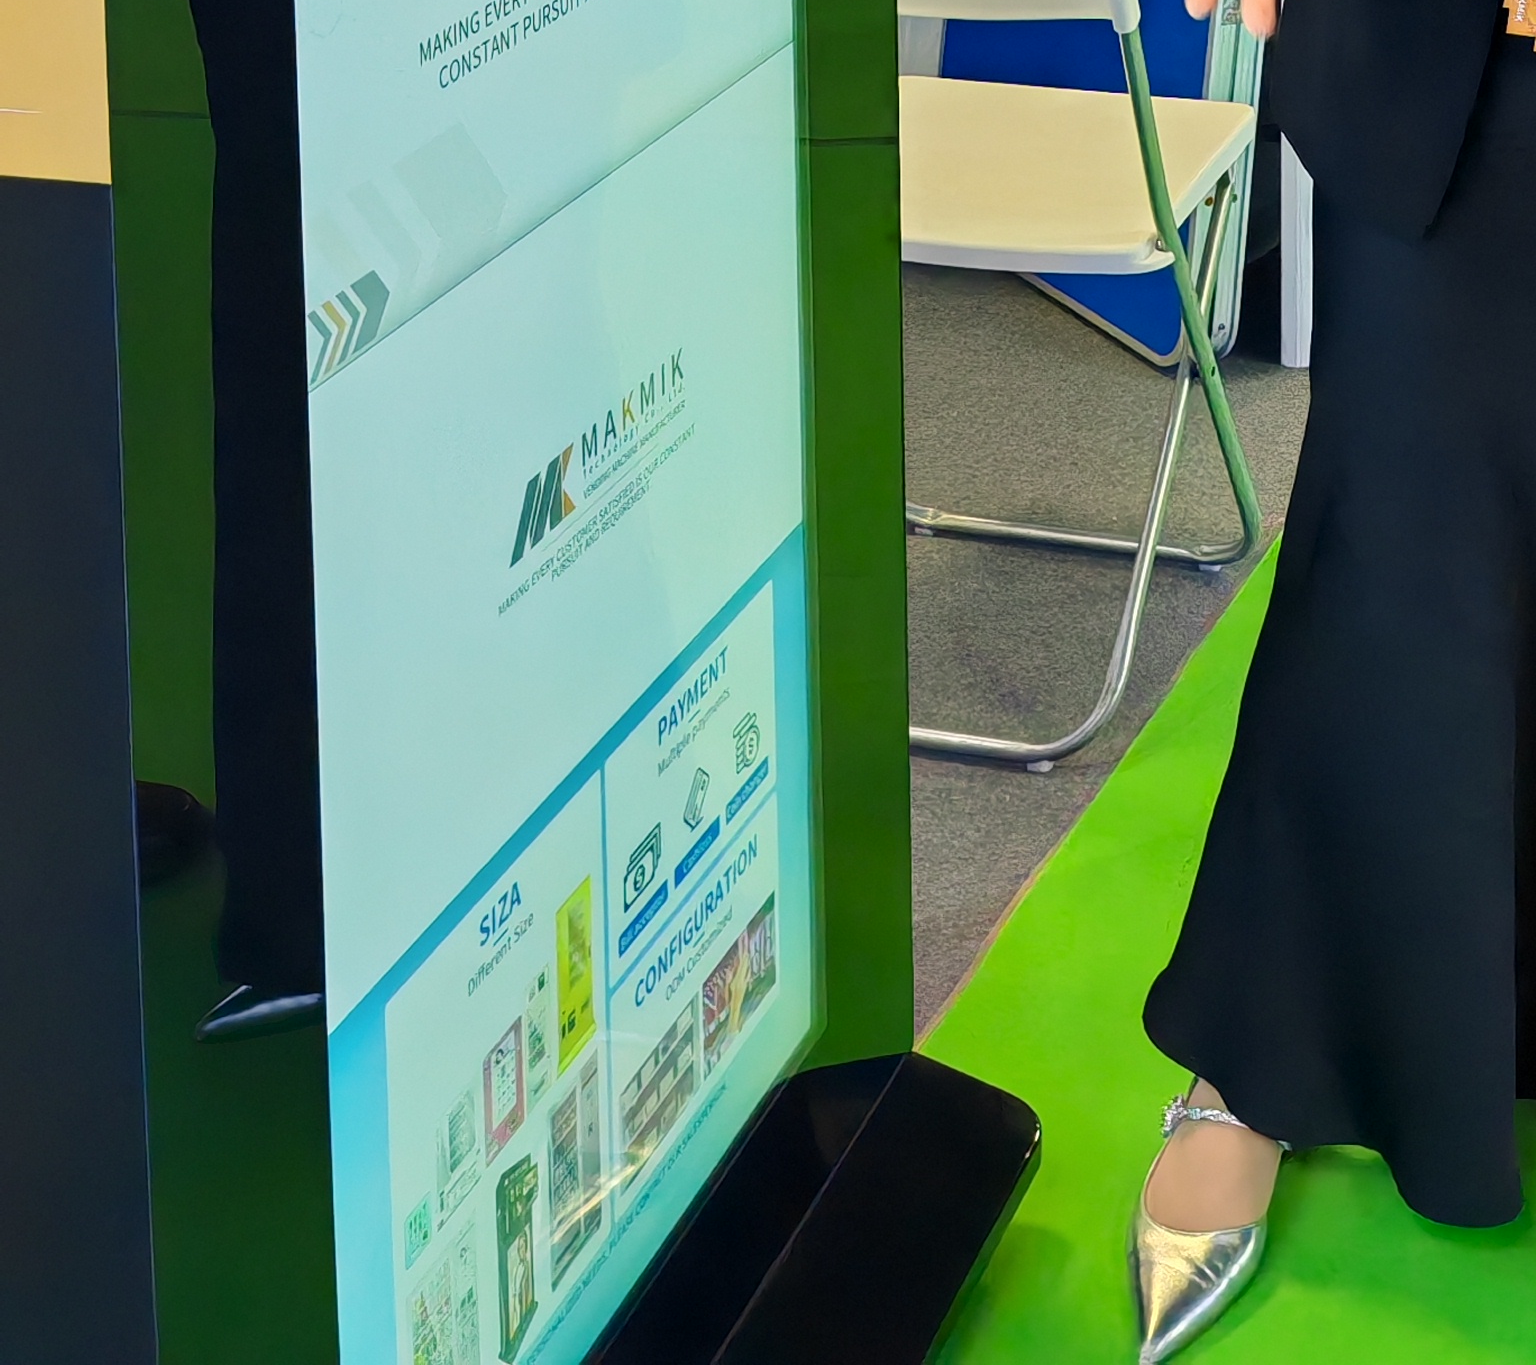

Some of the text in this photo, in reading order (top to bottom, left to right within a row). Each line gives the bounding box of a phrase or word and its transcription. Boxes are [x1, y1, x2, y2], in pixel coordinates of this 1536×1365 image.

[419, 11, 481, 67] MAKING
[439, 22, 519, 90] CONSTANT
[581, 347, 685, 467] MAKMIK
[658, 645, 729, 746] PAYMENT
[468, 912, 534, 997] Different Size
[479, 881, 521, 947] SIZA
[635, 833, 758, 1007] CONFIGURATION
